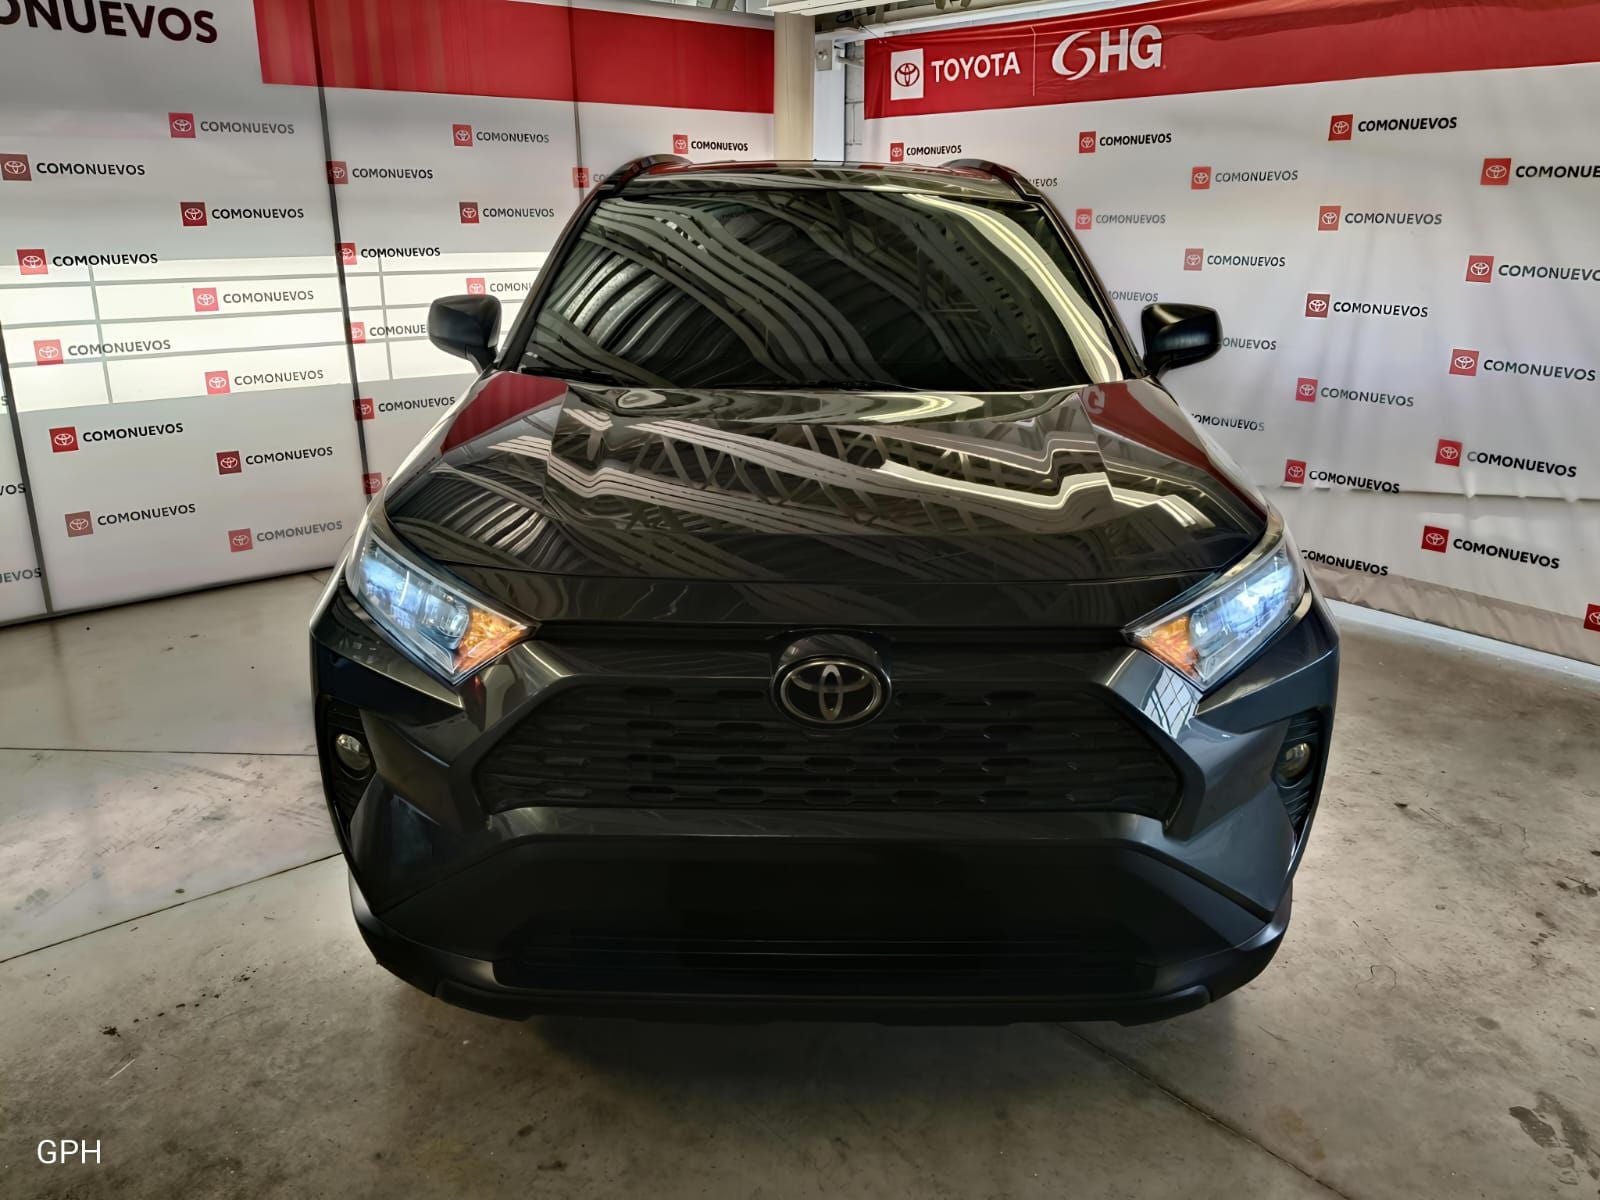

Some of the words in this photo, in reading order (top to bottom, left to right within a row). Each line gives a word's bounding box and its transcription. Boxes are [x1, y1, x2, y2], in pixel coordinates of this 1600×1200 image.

[931, 51, 1022, 83] TOYOTA
[200, 121, 296, 135] COMONUEVOS
[1357, 117, 1458, 132] COMONUEVOS
[476, 131, 550, 144] COMONUEVOS
[1099, 133, 1173, 147] COMONUEVOS
[690, 140, 749, 152] COMONUEVOS
[906, 144, 963, 157] COMONUEVOS
[36, 162, 146, 177] COMONUEVOS
[352, 168, 434, 180] COMONUEVOS
[1215, 170, 1299, 183] COMONUEVOS
[211, 208, 305, 220] COMONUEVOS
[482, 207, 555, 219] COMONUEVOS
[1095, 214, 1167, 225] COMONUEVOS
[1344, 212, 1443, 226] COMONUEVOS
[52, 253, 159, 267] COMONUEVOS
[360, 246, 441, 259] COMONUEVOS
[1207, 255, 1286, 268] COMONUEVOS
[222, 290, 314, 305] COMONUEVOS
[1333, 301, 1429, 319] COMONUEVOS
[67, 339, 172, 357] COMONUEVOS
[234, 369, 324, 387] COMONUEVOS
[1483, 359, 1597, 382] COMONUEVOS
[378, 396, 456, 413] COMONUEVOS
[1320, 386, 1415, 408] COMONUEVOS
[1192, 413, 1265, 432] OMONUEVOS
[82, 423, 184, 443] COMONUEVOS
[245, 446, 334, 466] COMONUEVOS
[1466, 451, 1578, 479] COMONUEVOS
[1308, 470, 1401, 494] COMONUEVOS
[97, 503, 197, 527] COMONUEVOS
[256, 520, 344, 543] COMONUEVOS
[1453, 538, 1561, 570] COMONUEVOS
